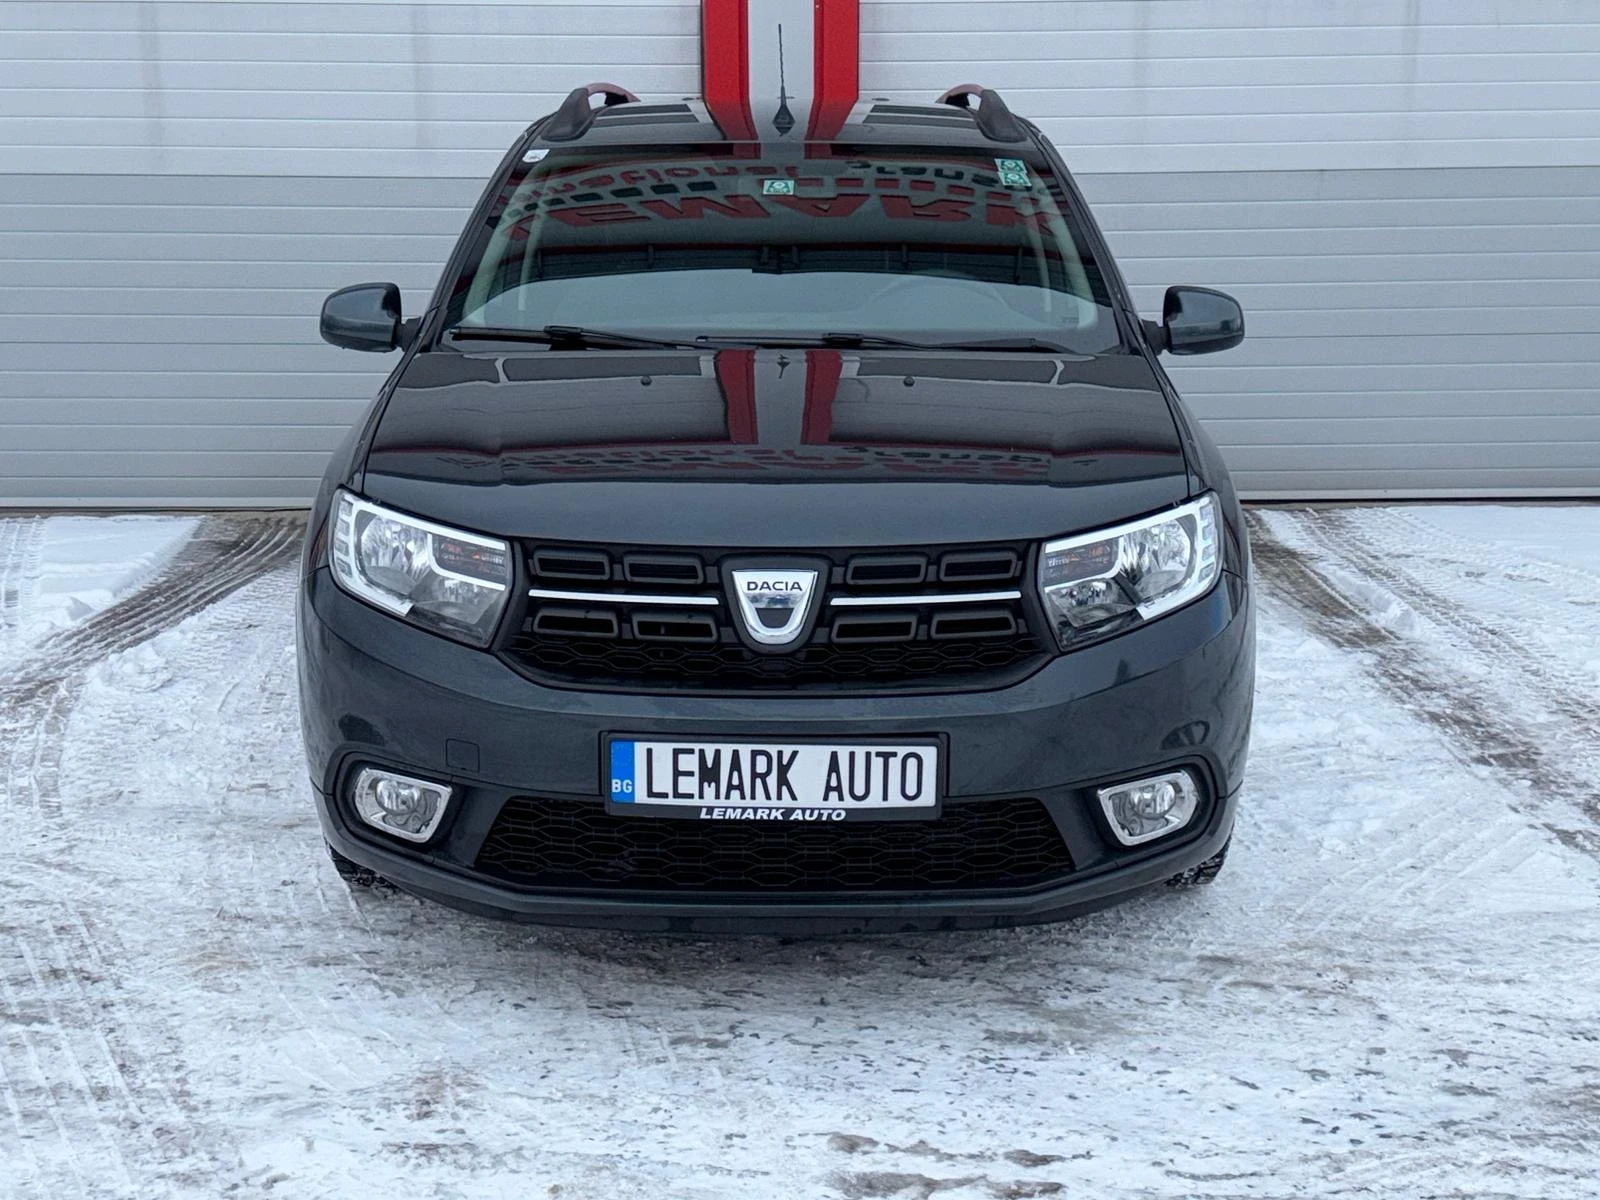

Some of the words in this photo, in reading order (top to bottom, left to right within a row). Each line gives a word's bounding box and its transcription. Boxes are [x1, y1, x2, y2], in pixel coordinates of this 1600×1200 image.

[746, 581, 803, 592] DACIA
[646, 747, 799, 801] LEMARK
[822, 750, 924, 802] AUTO
[611, 778, 633, 793] BG
[700, 807, 785, 821] LEMARK
[789, 808, 847, 822] AUTO
